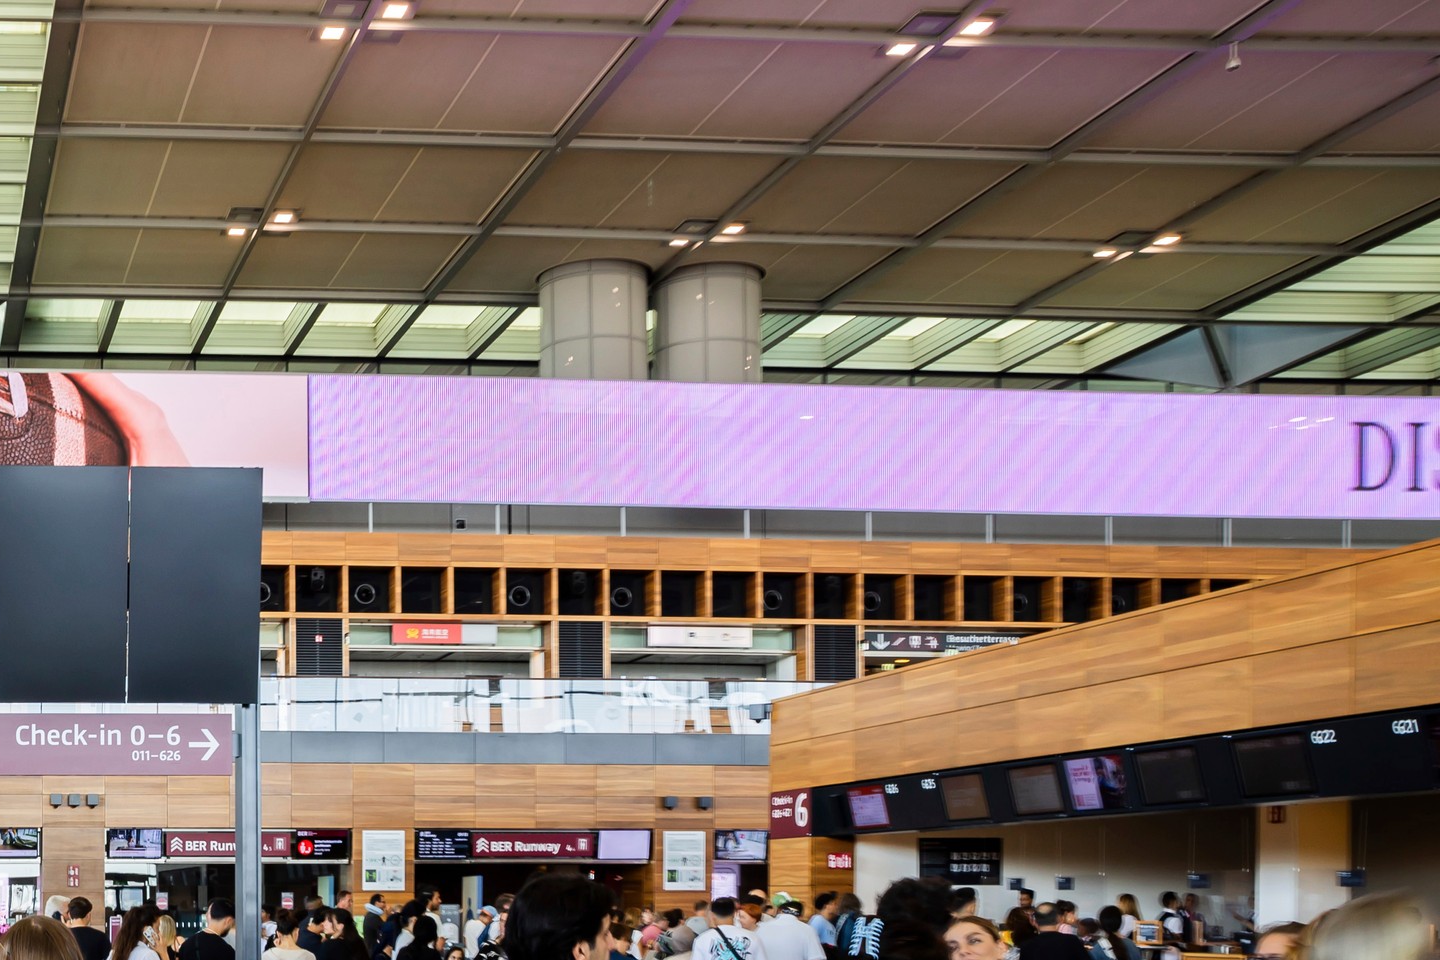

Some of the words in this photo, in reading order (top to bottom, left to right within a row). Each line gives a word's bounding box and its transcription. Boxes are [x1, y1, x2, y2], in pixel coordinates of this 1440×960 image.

[1348, 421, 1440, 491] DI
[15, 724, 122, 746] Check-in
[130, 725, 181, 746] 0–6
[131, 750, 181, 761] 011–626
[794, 792, 809, 827] 6
[185, 841, 207, 851] BER
[210, 841, 236, 851] Run
[490, 841, 512, 852] BER
[514, 841, 561, 854] Runway
